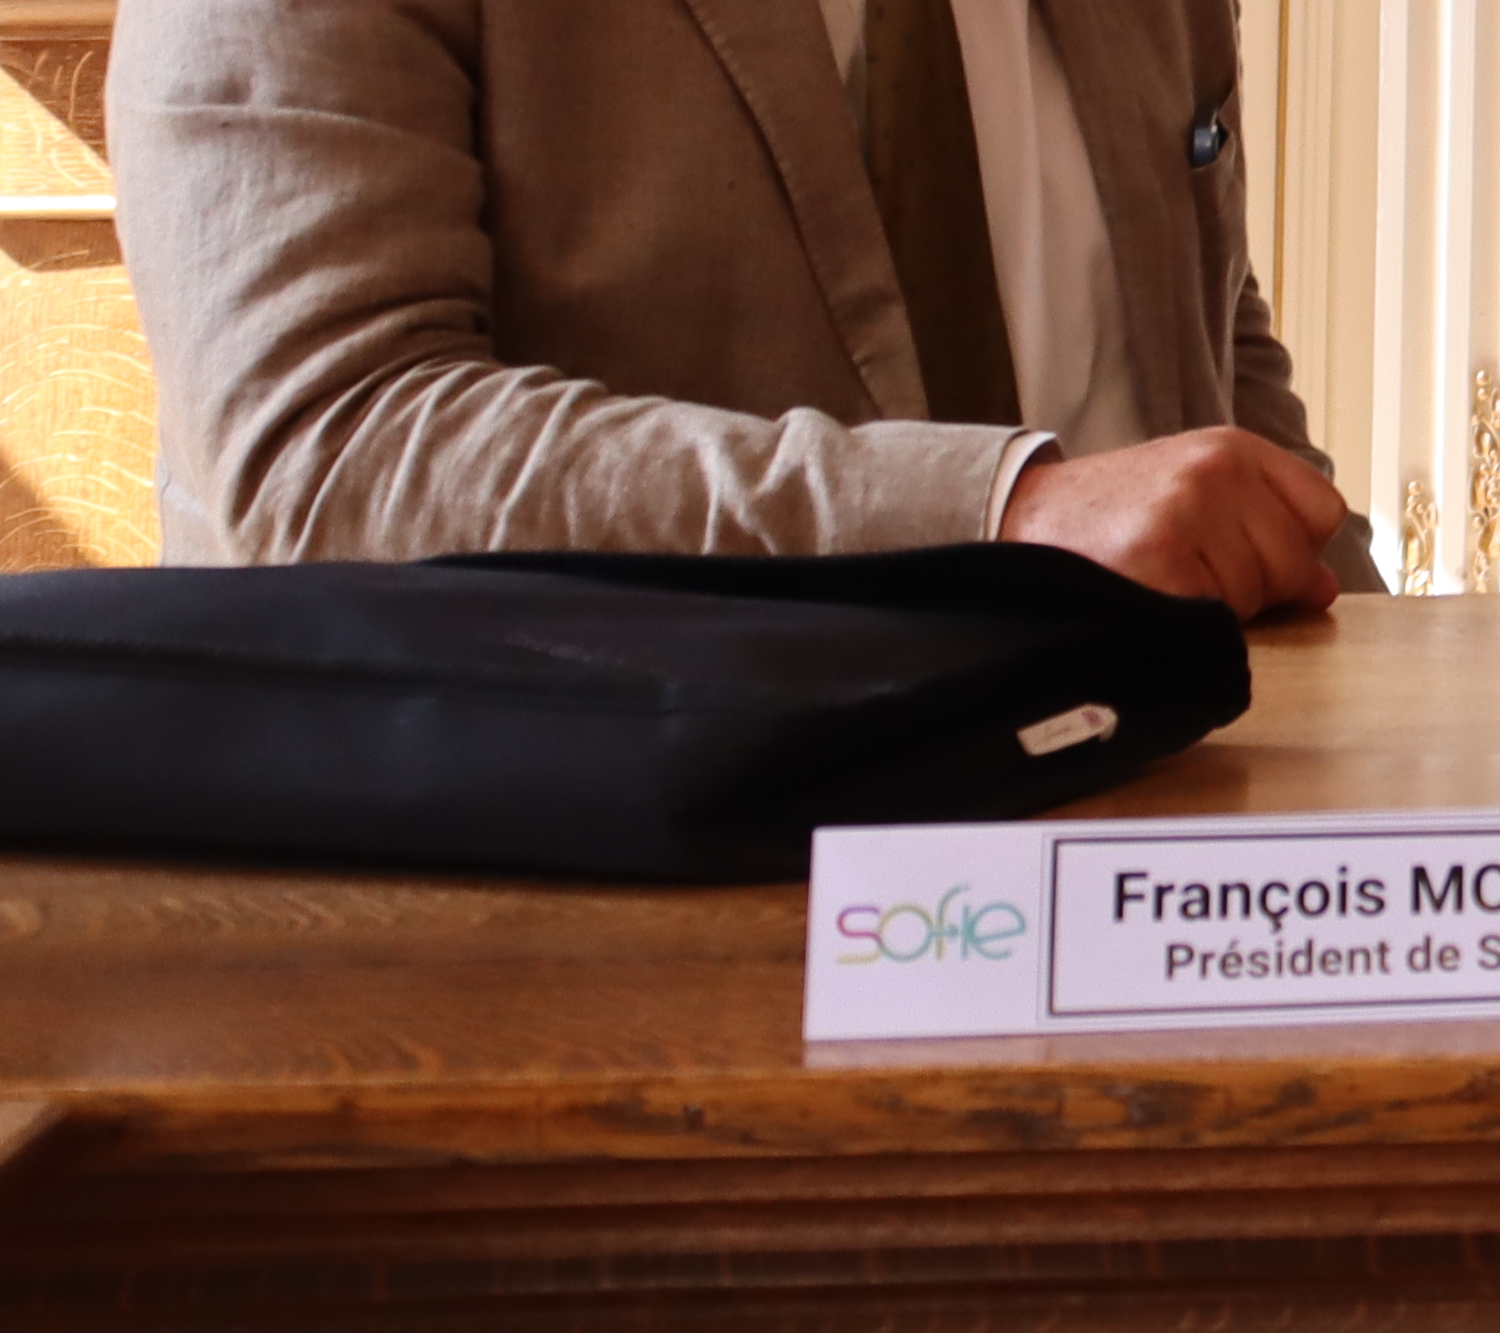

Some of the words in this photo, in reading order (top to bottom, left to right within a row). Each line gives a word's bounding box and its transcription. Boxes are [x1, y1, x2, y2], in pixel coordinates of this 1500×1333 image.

[1111, 865, 1388, 932] François
[1164, 936, 1392, 982] Président
[1406, 934, 1462, 974] de
